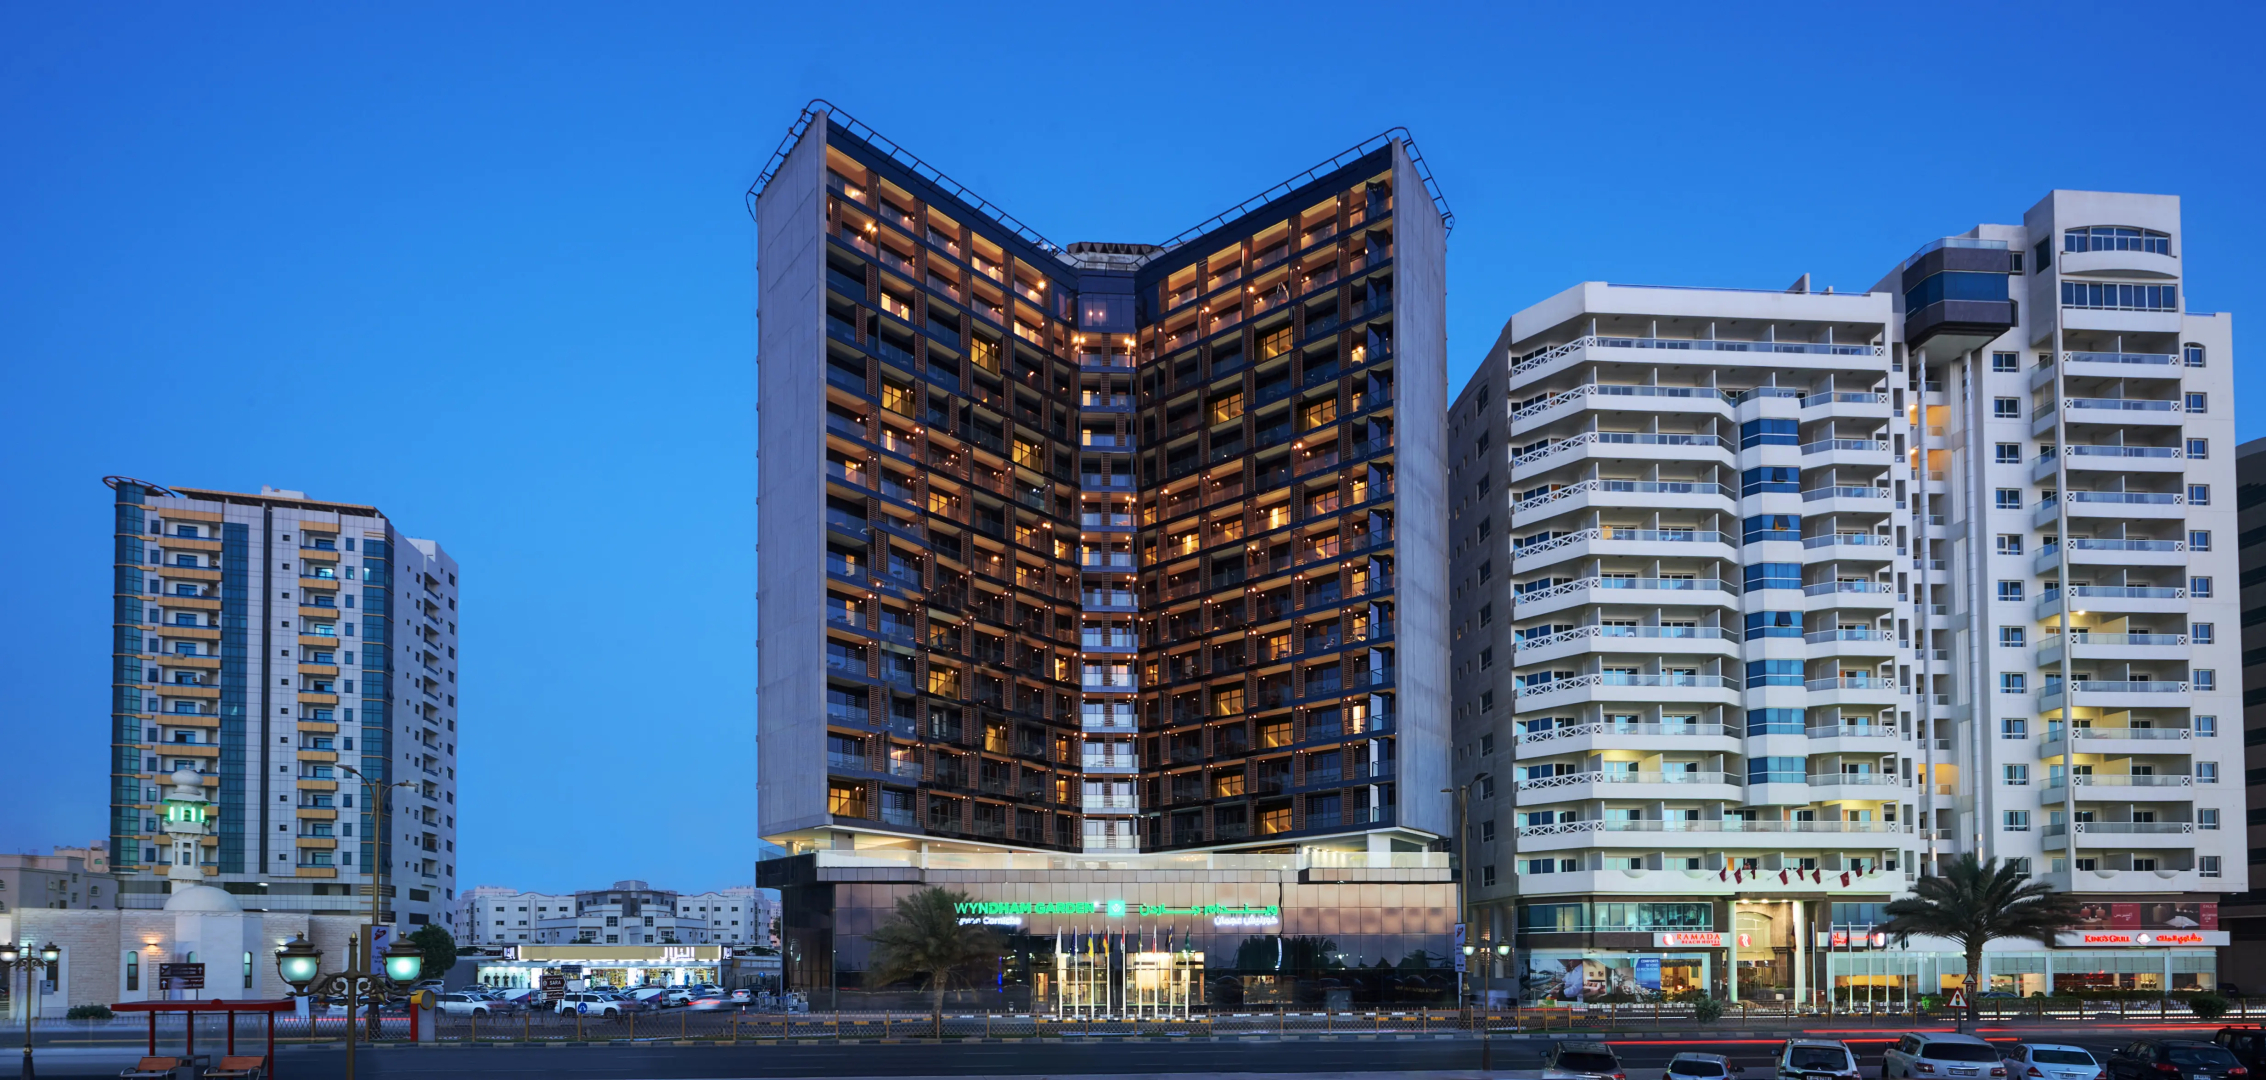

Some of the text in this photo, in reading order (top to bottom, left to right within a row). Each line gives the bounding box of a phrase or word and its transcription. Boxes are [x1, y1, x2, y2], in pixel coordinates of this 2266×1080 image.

[954, 902, 1095, 914] WYNDHAM GARDEN
[983, 916, 1022, 925] Corniche
